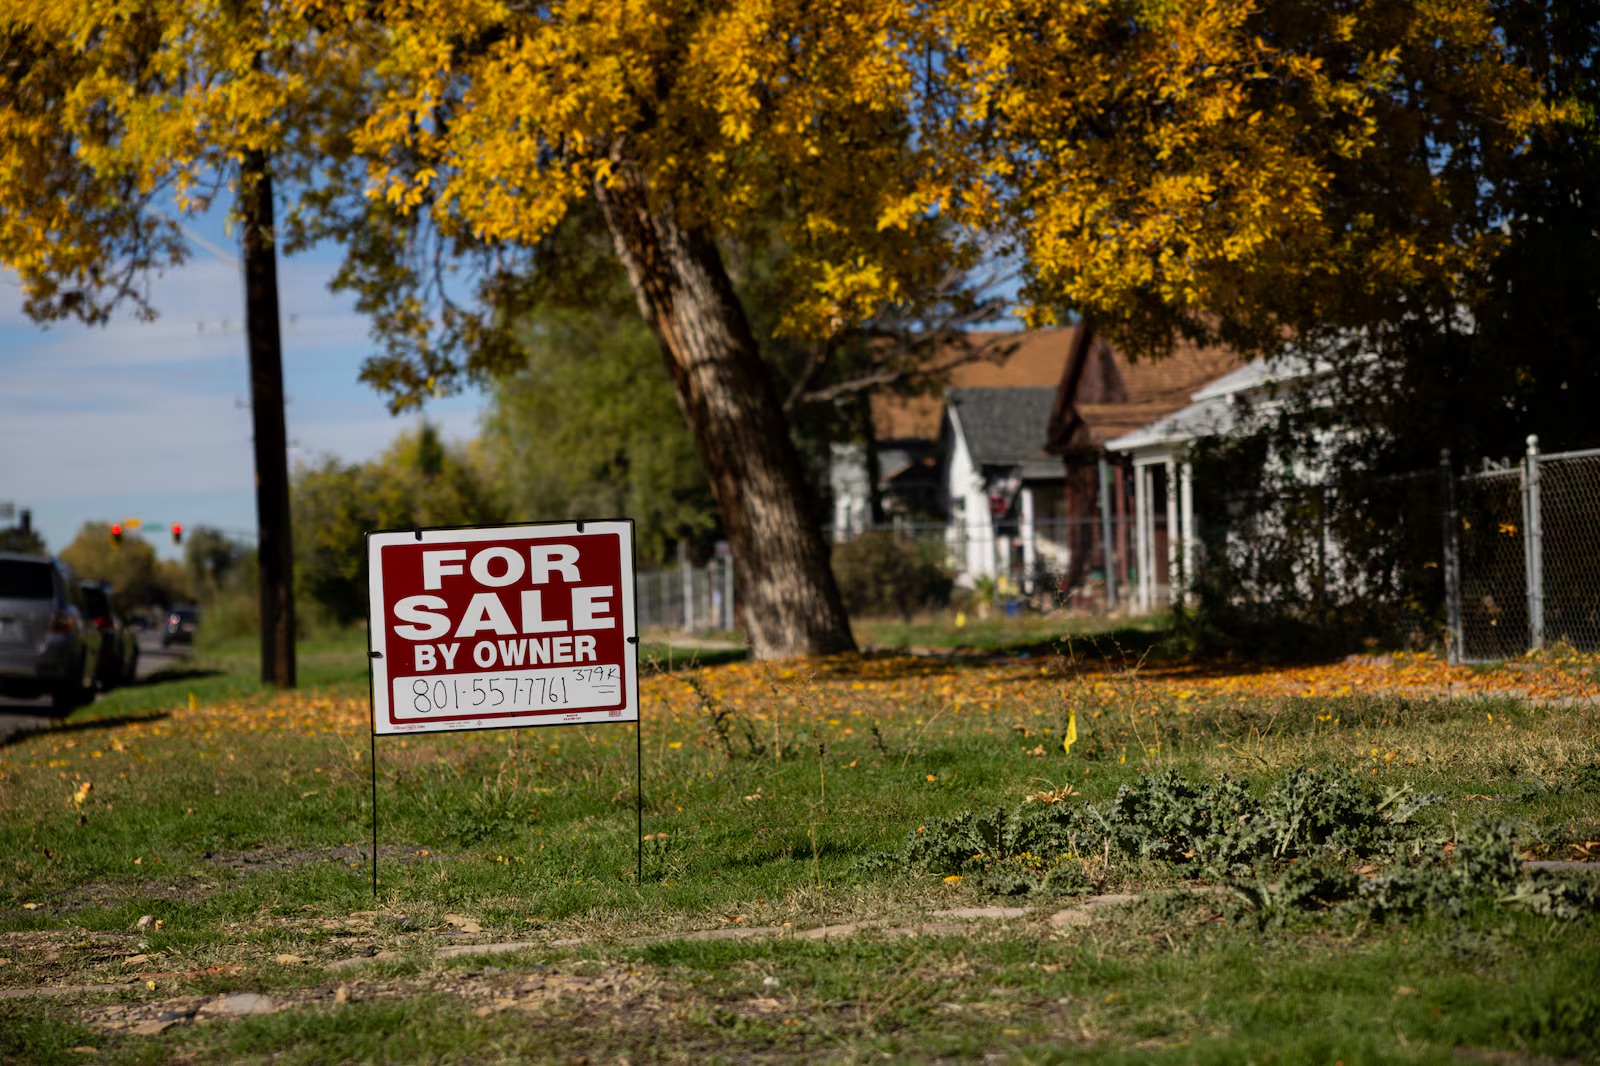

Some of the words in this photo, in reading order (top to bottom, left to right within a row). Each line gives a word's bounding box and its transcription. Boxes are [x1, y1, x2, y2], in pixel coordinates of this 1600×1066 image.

[422, 544, 581, 590] FOR
[393, 585, 616, 641] SALE
[414, 642, 460, 672] BY
[473, 635, 597, 668] OWNER
[412, 676, 569, 713] 801-557-7761
